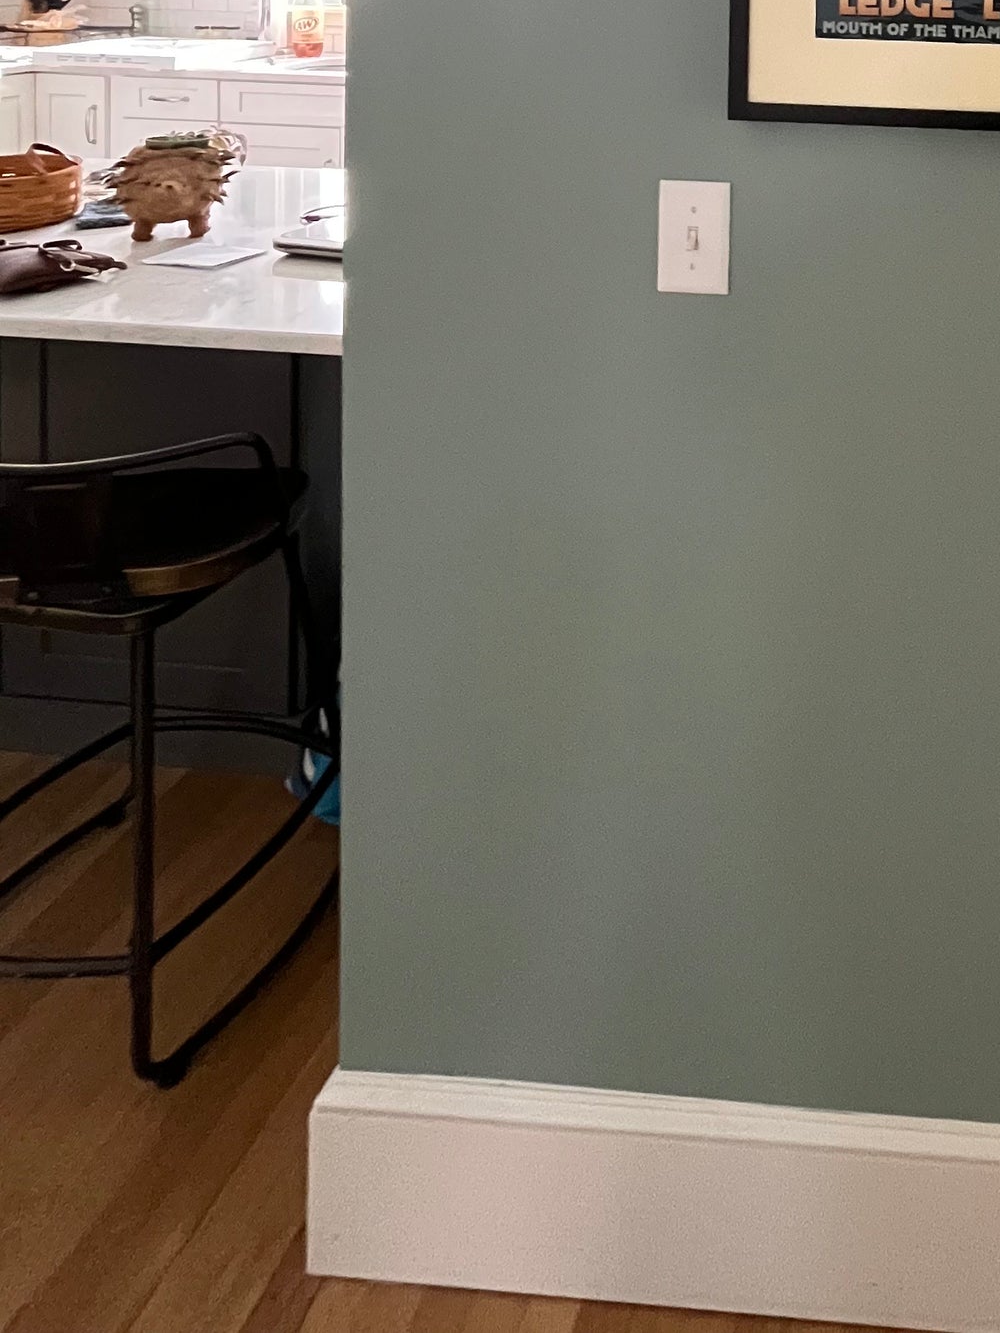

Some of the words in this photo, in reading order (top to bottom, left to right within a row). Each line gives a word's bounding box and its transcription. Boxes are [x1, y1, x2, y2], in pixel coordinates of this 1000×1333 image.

[822, 20, 883, 36] MOUTH
[887, 22, 908, 36] OF
[914, 24, 947, 38] THE
